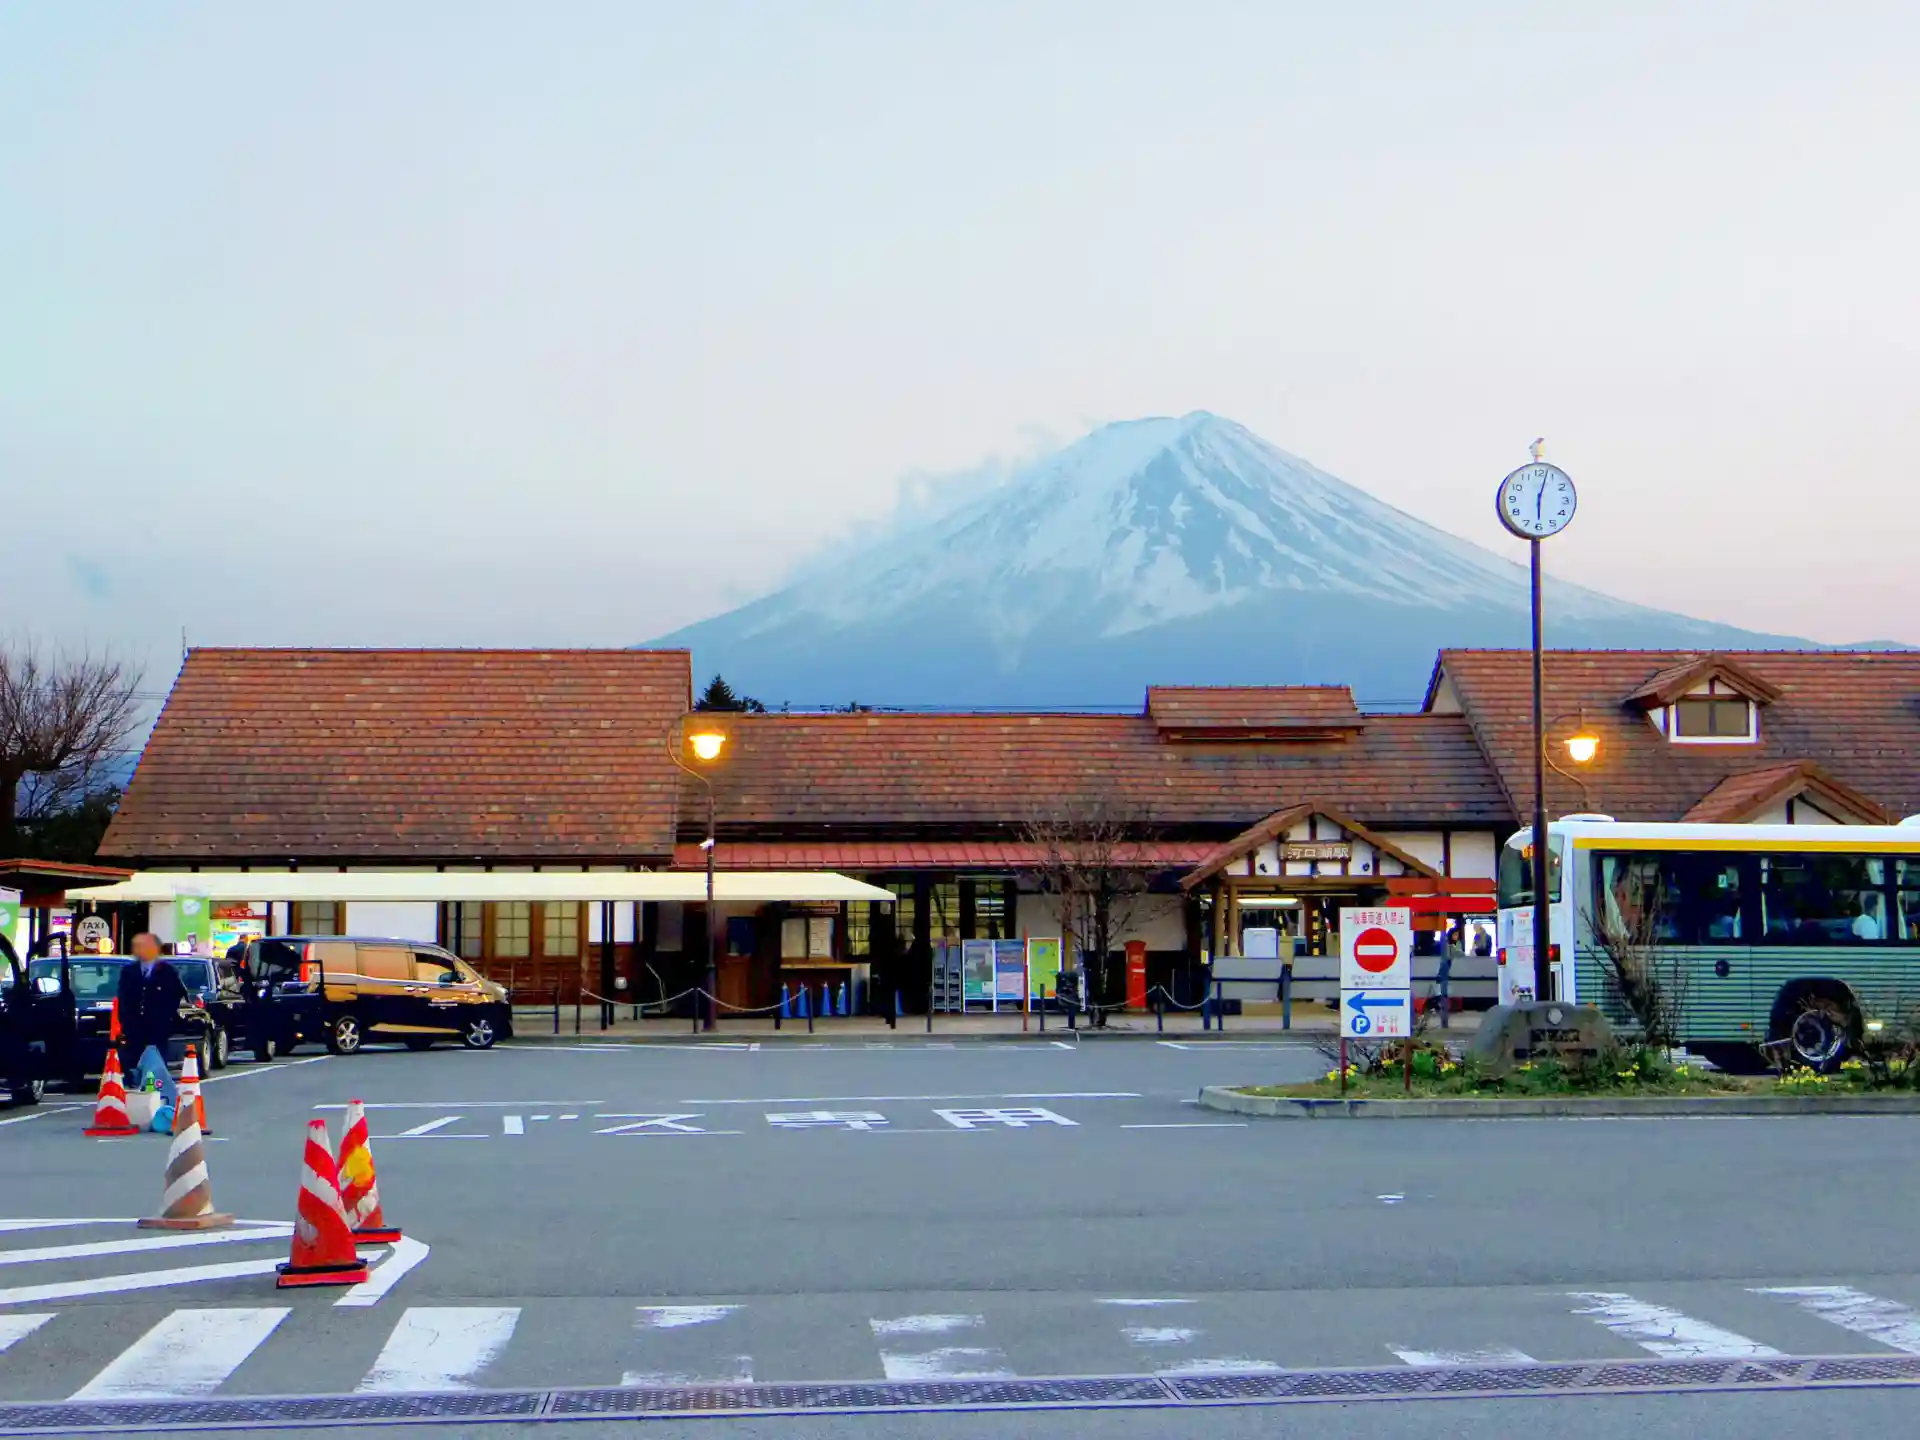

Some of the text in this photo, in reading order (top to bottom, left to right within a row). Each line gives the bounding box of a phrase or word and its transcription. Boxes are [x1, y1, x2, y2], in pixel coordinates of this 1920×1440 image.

[1534, 469, 1545, 477] 12
[1512, 484, 1523, 492] 10
[1558, 483, 1566, 491] 2
[1512, 508, 1520, 516] 8
[1522, 519, 1530, 527] 7
[1534, 523, 1543, 531] 6
[1549, 519, 1557, 527] 5
[1356, 1018, 1367, 1032] P
